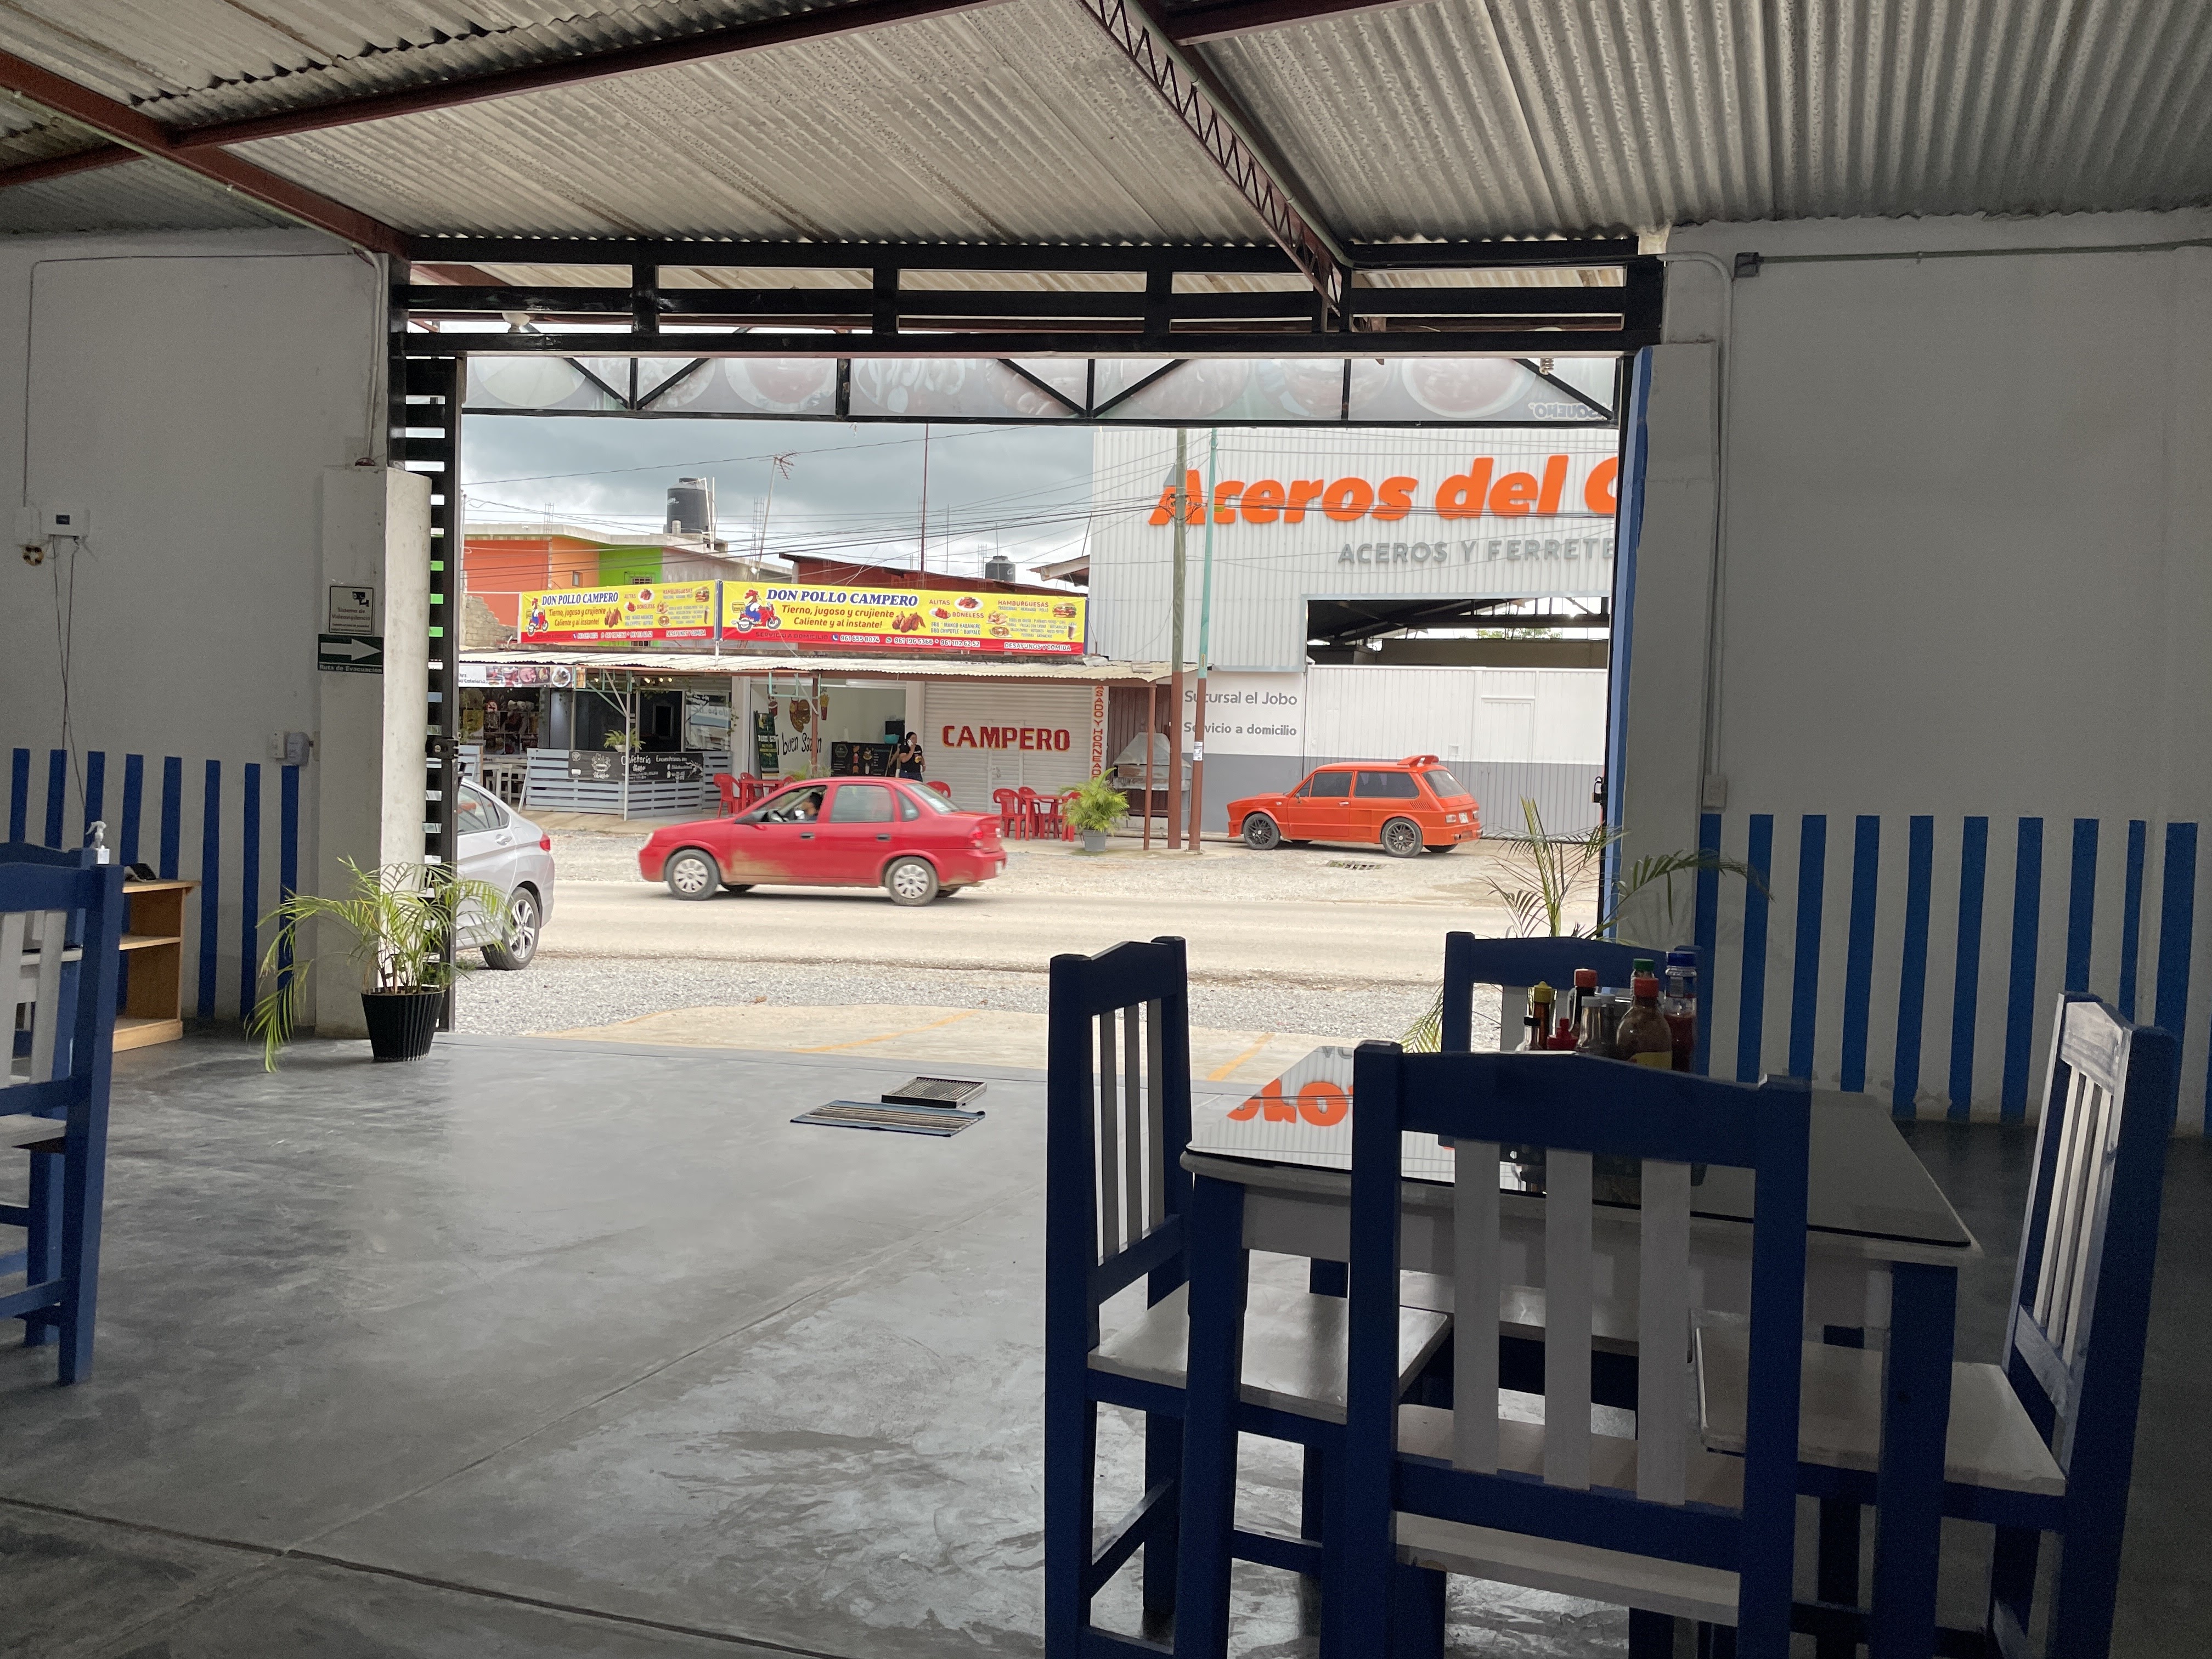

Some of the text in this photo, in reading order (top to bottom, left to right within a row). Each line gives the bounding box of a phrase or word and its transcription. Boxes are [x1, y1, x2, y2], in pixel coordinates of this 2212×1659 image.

[1148, 466, 1419, 525] Aceros
[1436, 455, 1569, 518] del
[1338, 541, 1448, 563] ACEROS
[1460, 540, 1476, 561] Y
[541, 592, 618, 605] DON POLLO CAMPERO
[766, 589, 918, 606] DON POLLO CAMPERO
[565, 608, 580, 618] jugoso
[782, 605, 812, 615] Tierno,
[814, 606, 845, 617] jugoso
[855, 608, 895, 618] crujiente
[794, 617, 828, 626] Caliente
[836, 619, 844, 627] al
[846, 619, 883, 628] instante!
[1184, 690, 1297, 706] Sursal el Jobo
[1184, 722, 1232, 733] Svicio
[1246, 724, 1297, 736] domicilio
[782, 732, 799, 755] buen
[802, 732, 822, 753] Sazn
[942, 725, 1070, 752] CAMPERO
